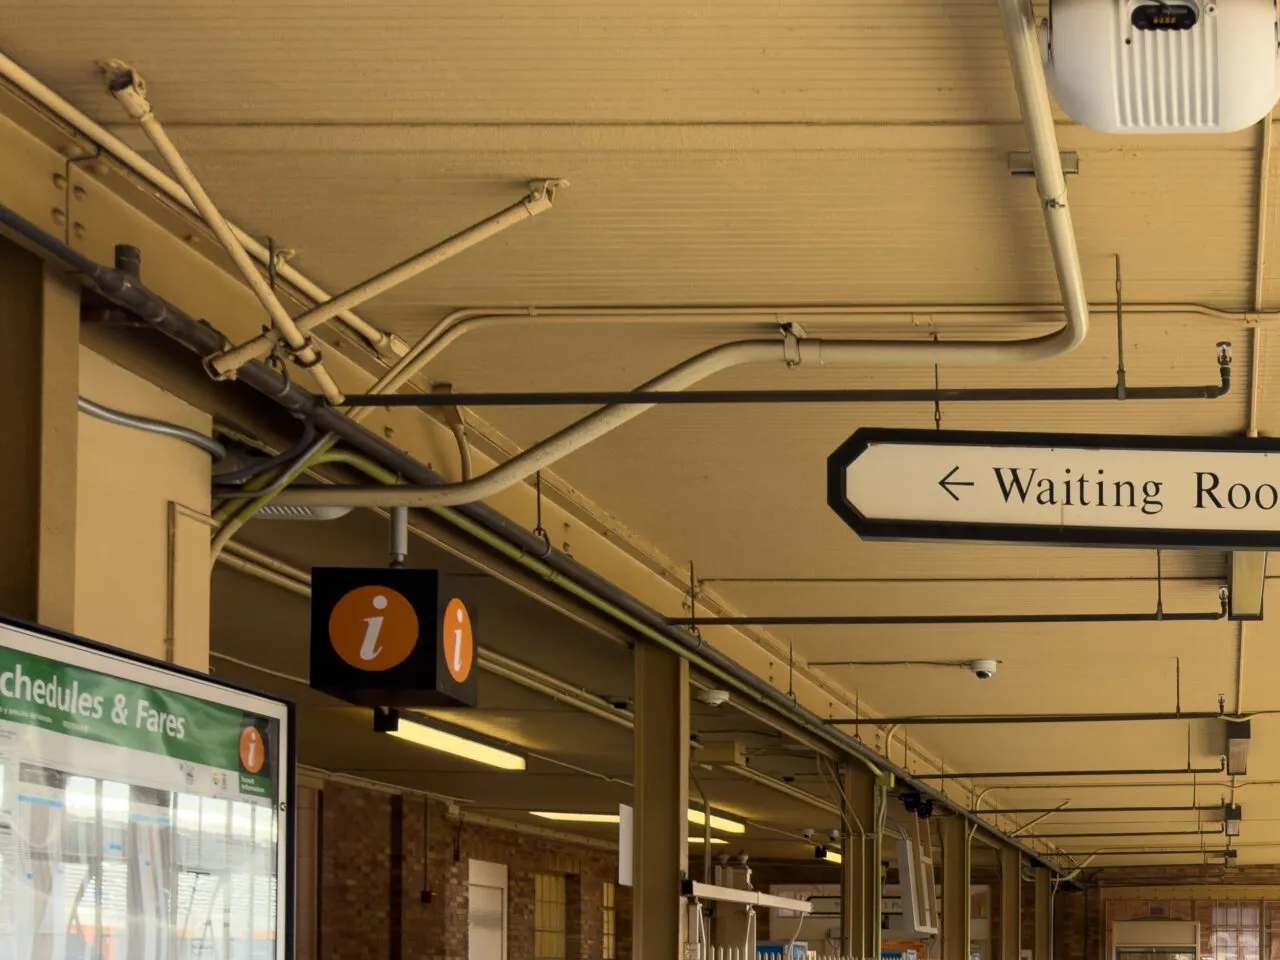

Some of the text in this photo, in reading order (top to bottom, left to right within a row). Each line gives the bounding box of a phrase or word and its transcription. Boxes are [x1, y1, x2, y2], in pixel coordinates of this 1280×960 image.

[991, 466, 1164, 515] Waiting
[111, 693, 128, 726] &
[136, 699, 187, 740] Fares
